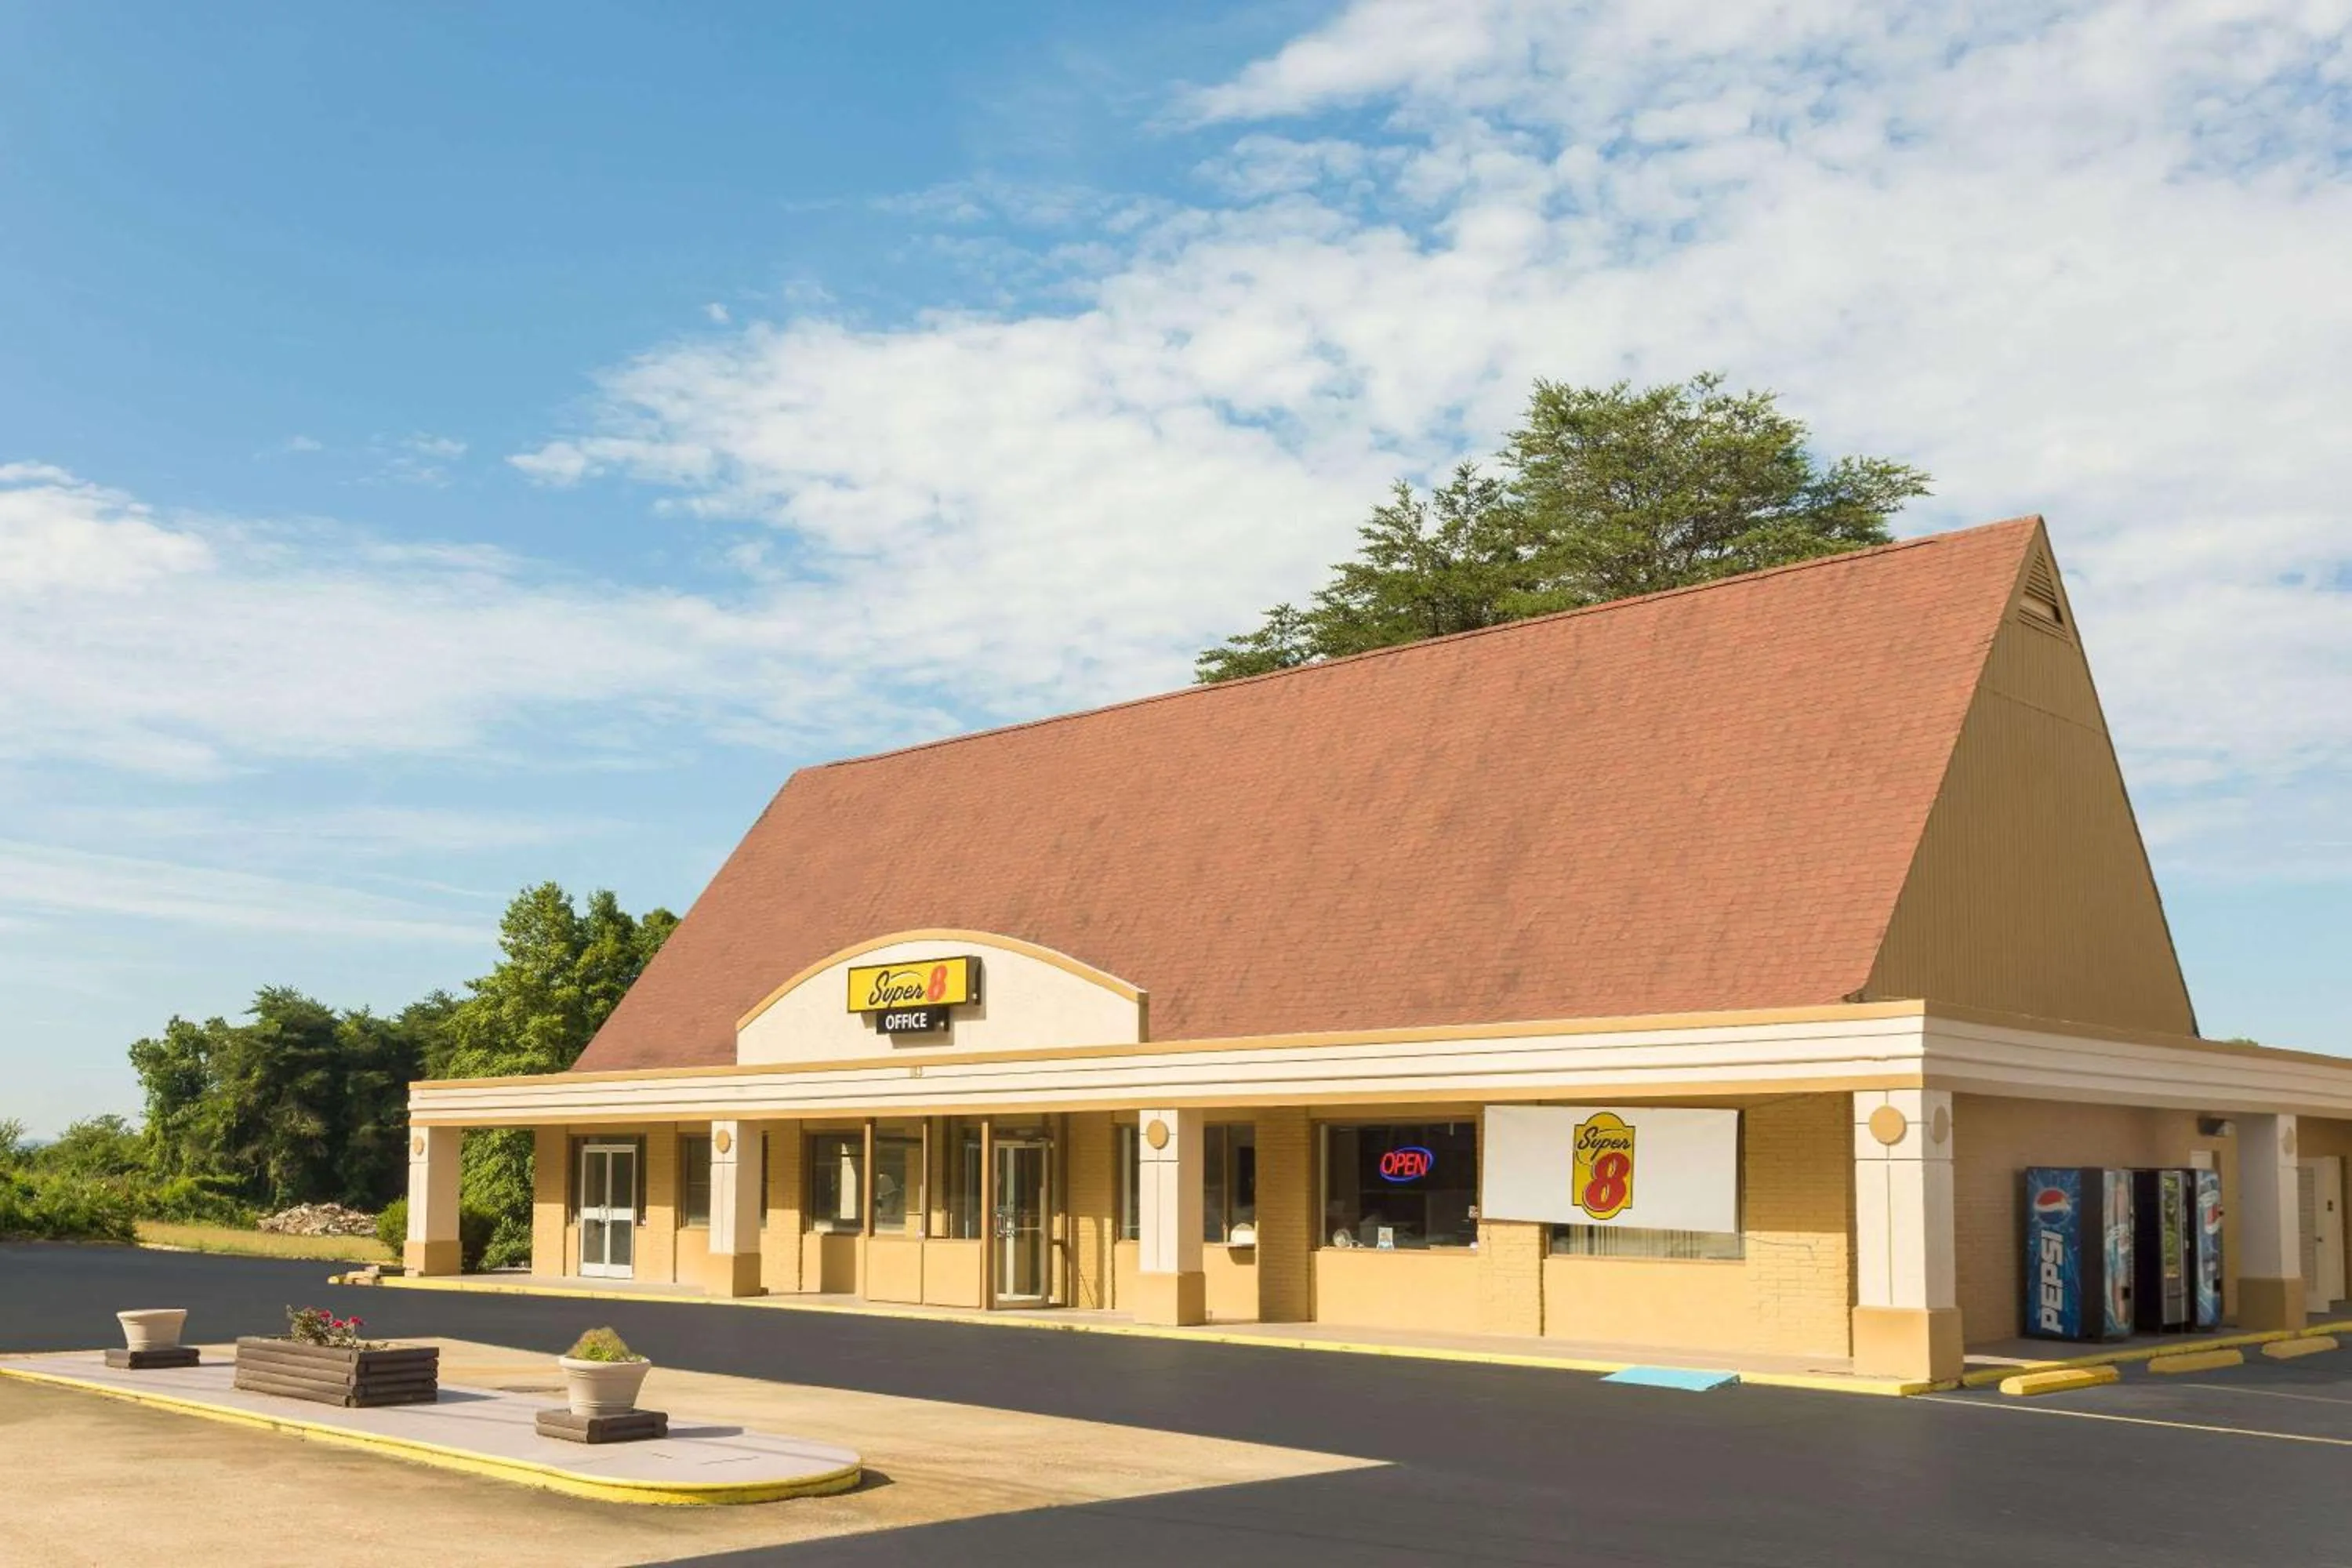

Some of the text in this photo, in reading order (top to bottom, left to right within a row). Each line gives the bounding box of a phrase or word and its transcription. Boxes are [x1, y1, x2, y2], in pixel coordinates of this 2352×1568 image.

[869, 964, 947, 1007] Super 8
[885, 1012, 927, 1029] OFFICE
[1577, 1126, 1631, 1161] Super
[1381, 1152, 1427, 1176] OPEN
[1584, 1151, 1631, 1212] 8
[2041, 1229, 2063, 1334] PEPSI
